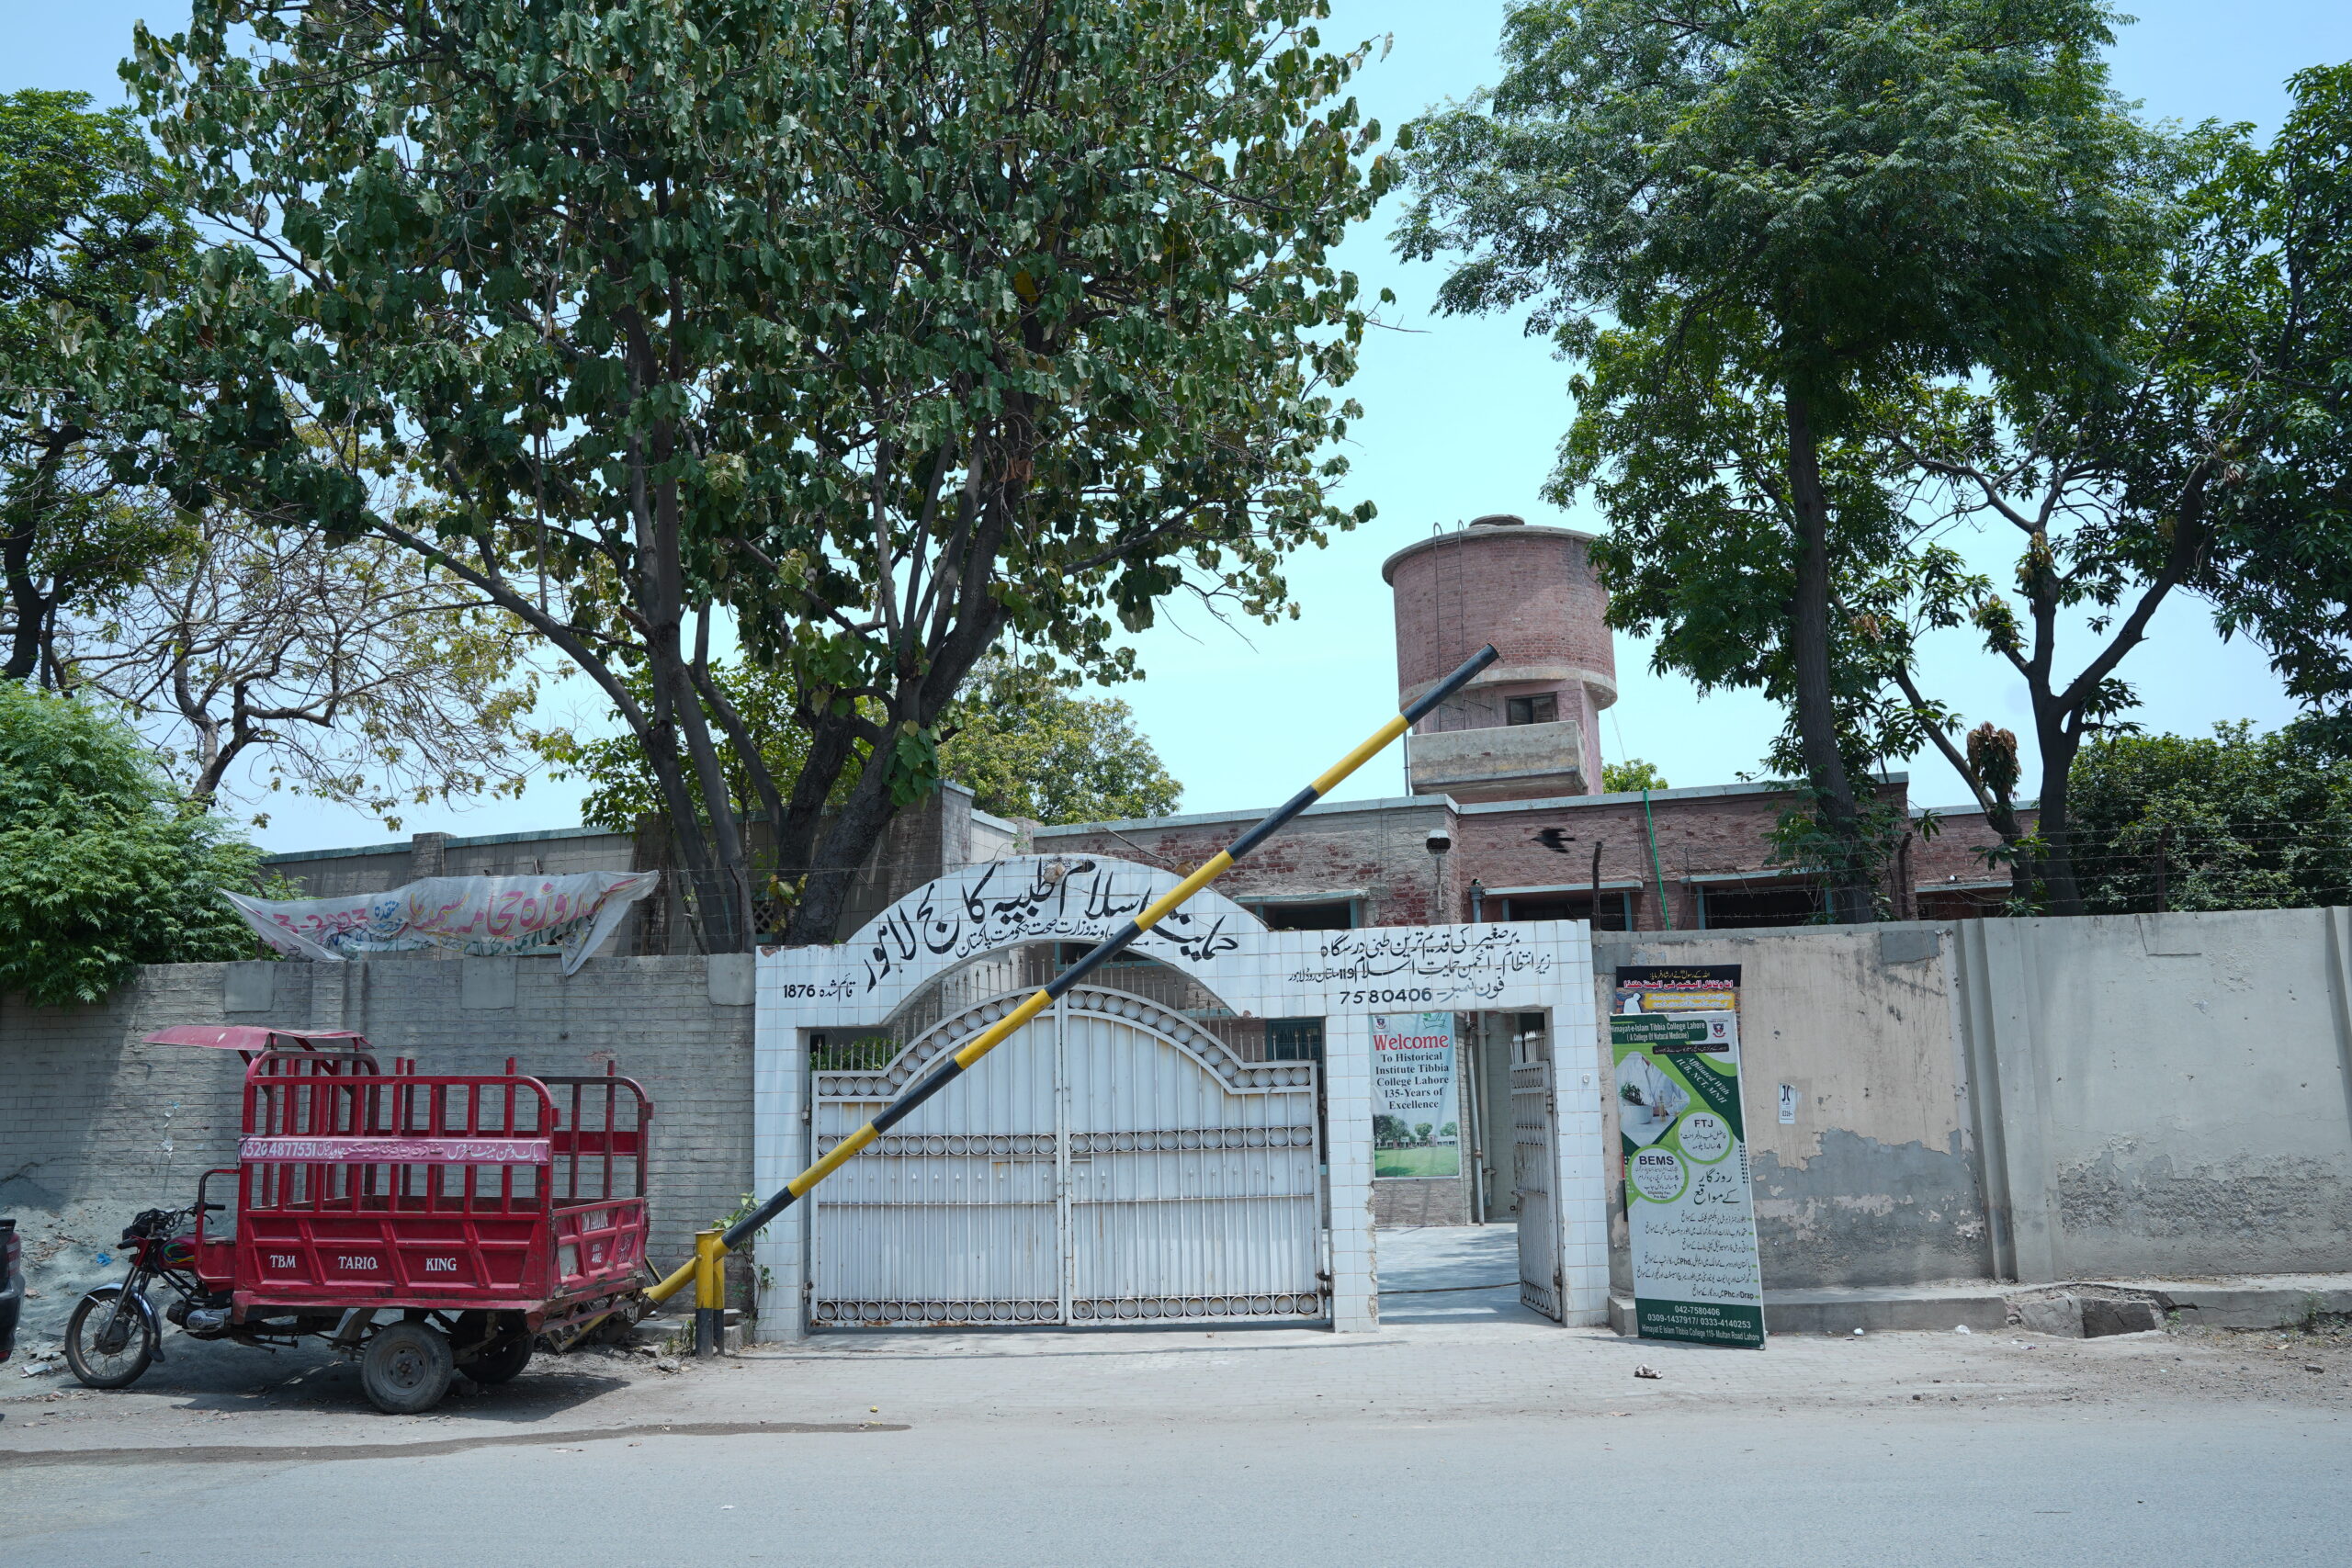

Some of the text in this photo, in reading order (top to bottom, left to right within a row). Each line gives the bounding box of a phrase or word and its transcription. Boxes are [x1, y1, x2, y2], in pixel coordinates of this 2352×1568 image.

[991, 856, 1057, 925] طبیہ
[1059, 859, 1152, 920] اسلام
[917, 863, 998, 955] کالج
[1027, 919, 1057, 936] صحت
[956, 922, 992, 959] پاکستان
[1390, 931, 1424, 958] ترین
[1422, 931, 1452, 961] قدیم
[1451, 925, 1471, 954] کی
[864, 904, 917, 994] لاہور
[1353, 955, 1416, 984] اسلام
[1457, 949, 1490, 978] انجمن
[1502, 951, 1534, 976] انتظام
[1287, 969, 1306, 983] لاہور
[1304, 966, 1317, 983] روڈ
[1315, 966, 1340, 983] ملتان
[1339, 968, 1355, 980] 119
[1701, 969, 1711, 978] اللہ
[783, 984, 816, 998] 1876
[819, 979, 839, 998] شدہ
[1340, 976, 1505, 1005] فون نمبر 7580406
[1650, 1022, 1666, 1031] Tibbia
[1666, 1021, 1686, 1032] College
[1687, 1021, 1705, 1030] Lahore
[1373, 1033, 1449, 1051] Welcome
[1634, 1032, 1648, 1042] College
[1654, 1032, 1669, 1040] Natural
[1381, 1052, 1442, 1063] To Historical
[1375, 1064, 1449, 1075] Institute Tibbia
[1686, 1057, 1731, 1095] Affiliated With
[1376, 1076, 1449, 1088] College Lahore
[1691, 1072, 1709, 1088] NCT,
[1707, 1088, 1727, 1103] MNH
[1385, 1087, 1443, 1099] 135-Years of
[1389, 1100, 1439, 1110] Excellence
[1694, 1119, 1713, 1128] FTJ
[1713, 1130, 1726, 1141] فاضل
[1639, 1156, 1675, 1166] BEMS
[1699, 1168, 1733, 1183] روزگار
[1693, 1183, 1741, 1205] کے مواقع
[270, 1255, 457, 1271] TBM TARIQ KING
[1724, 1290, 1736, 1298] Phc
[1739, 1291, 1755, 1300] Drap
[1674, 1304, 1721, 1316] 042-7580406
[1700, 1317, 1751, 1329] 0333-4140253
[1642, 1324, 1659, 1335] Himayat
[1663, 1325, 1675, 1334] Islam
[1675, 1326, 1690, 1336] Tibbia
[1689, 1327, 1706, 1339] College
[1715, 1329, 1731, 1339] Multan
[1731, 1330, 1744, 1340] Road
[1744, 1331, 1760, 1342] Lahore
